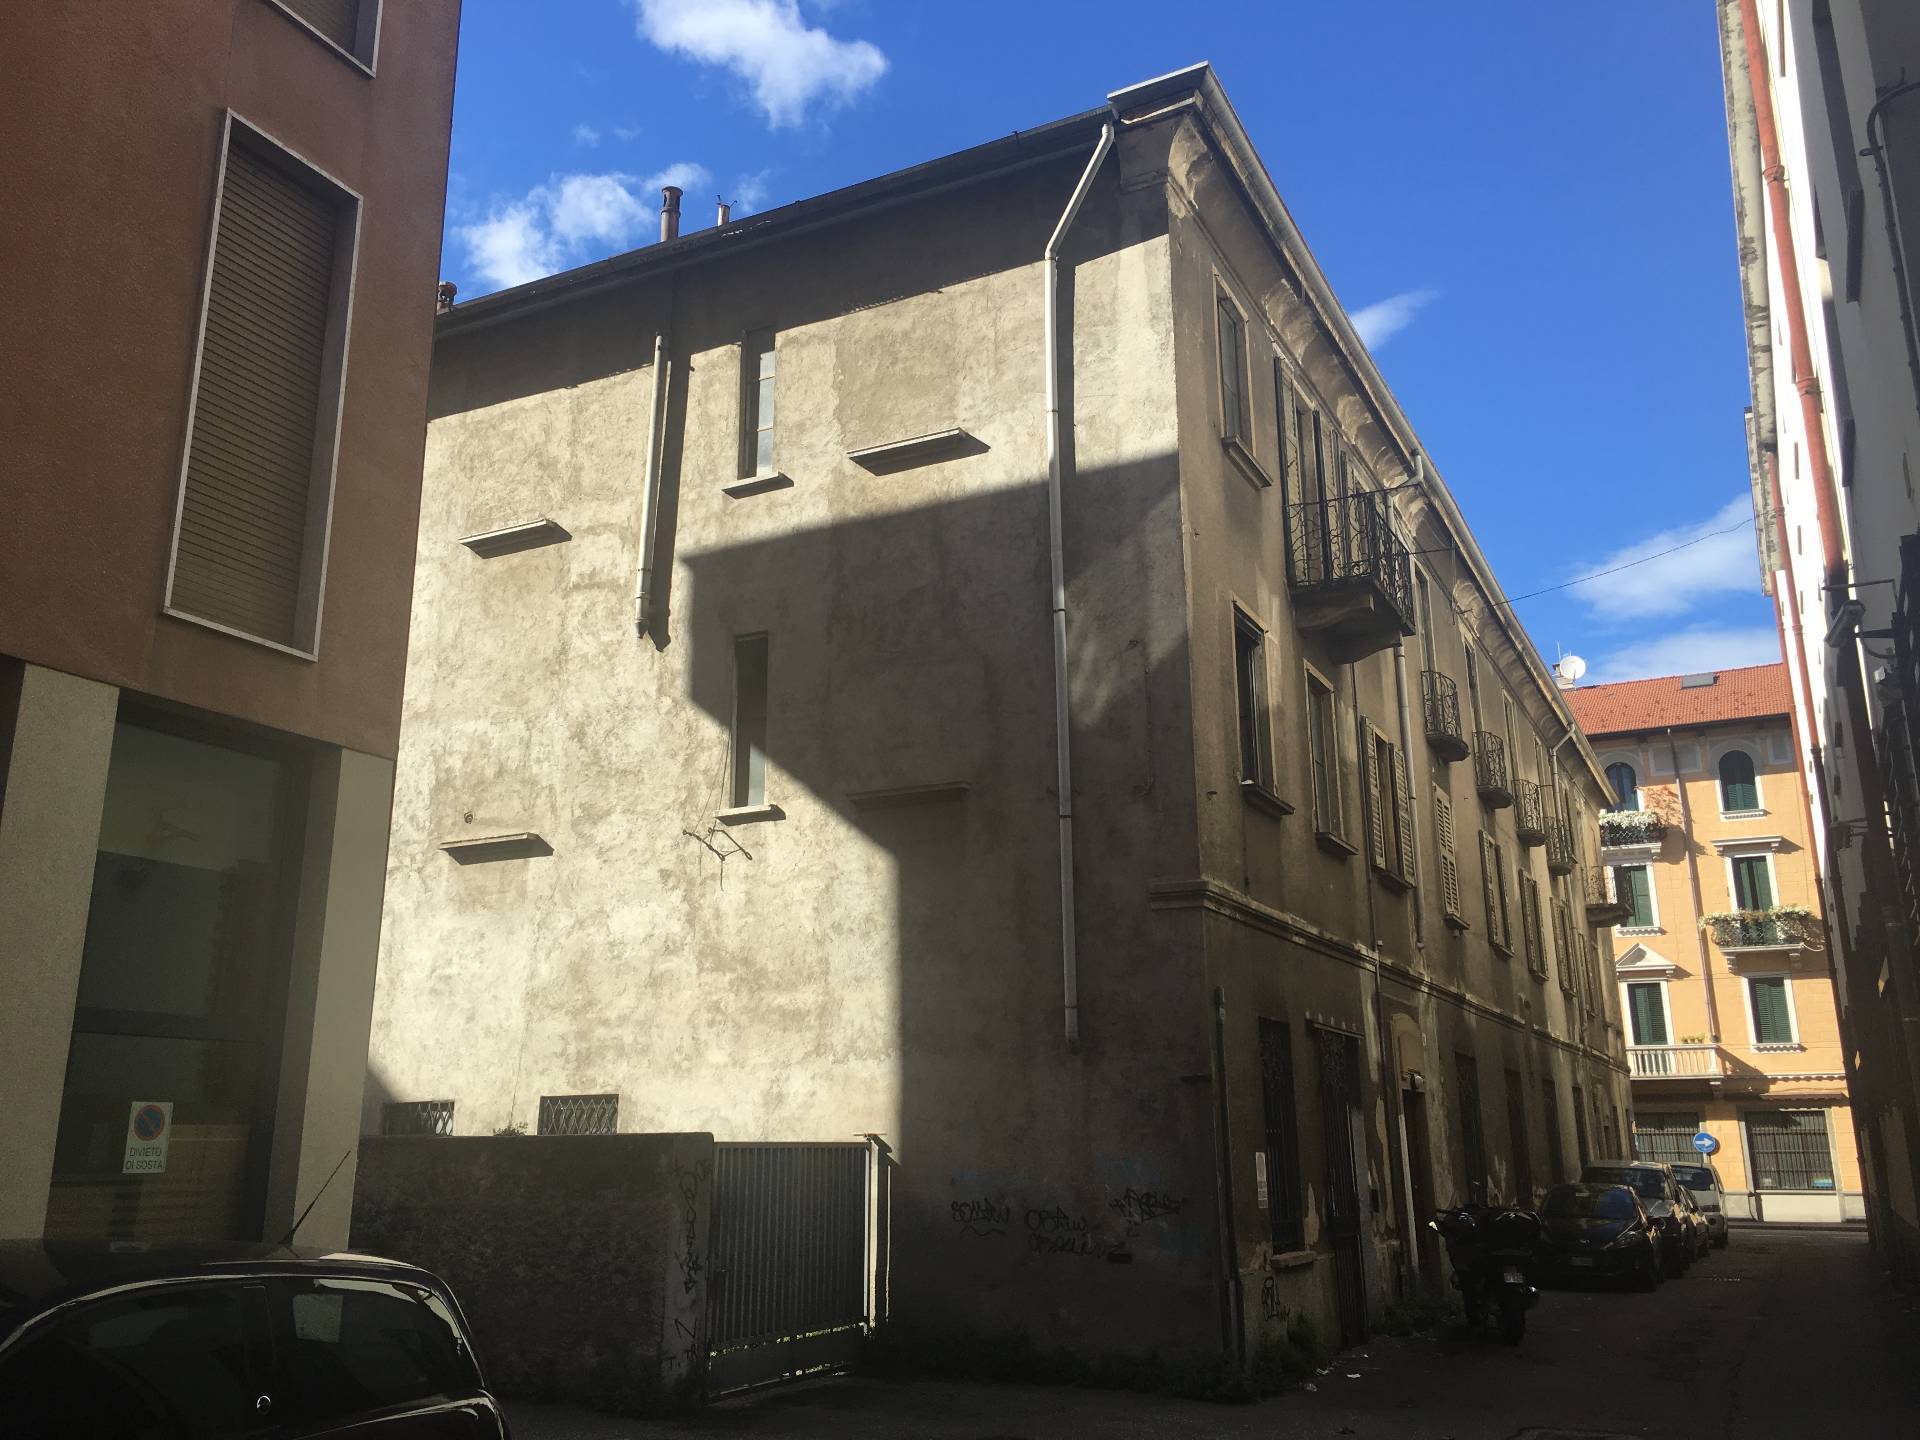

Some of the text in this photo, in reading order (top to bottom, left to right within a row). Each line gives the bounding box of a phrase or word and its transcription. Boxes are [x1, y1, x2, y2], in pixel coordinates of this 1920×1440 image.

[129, 1147, 161, 1157] DIVIETO
[126, 1161, 162, 1170] DI SOSTA
